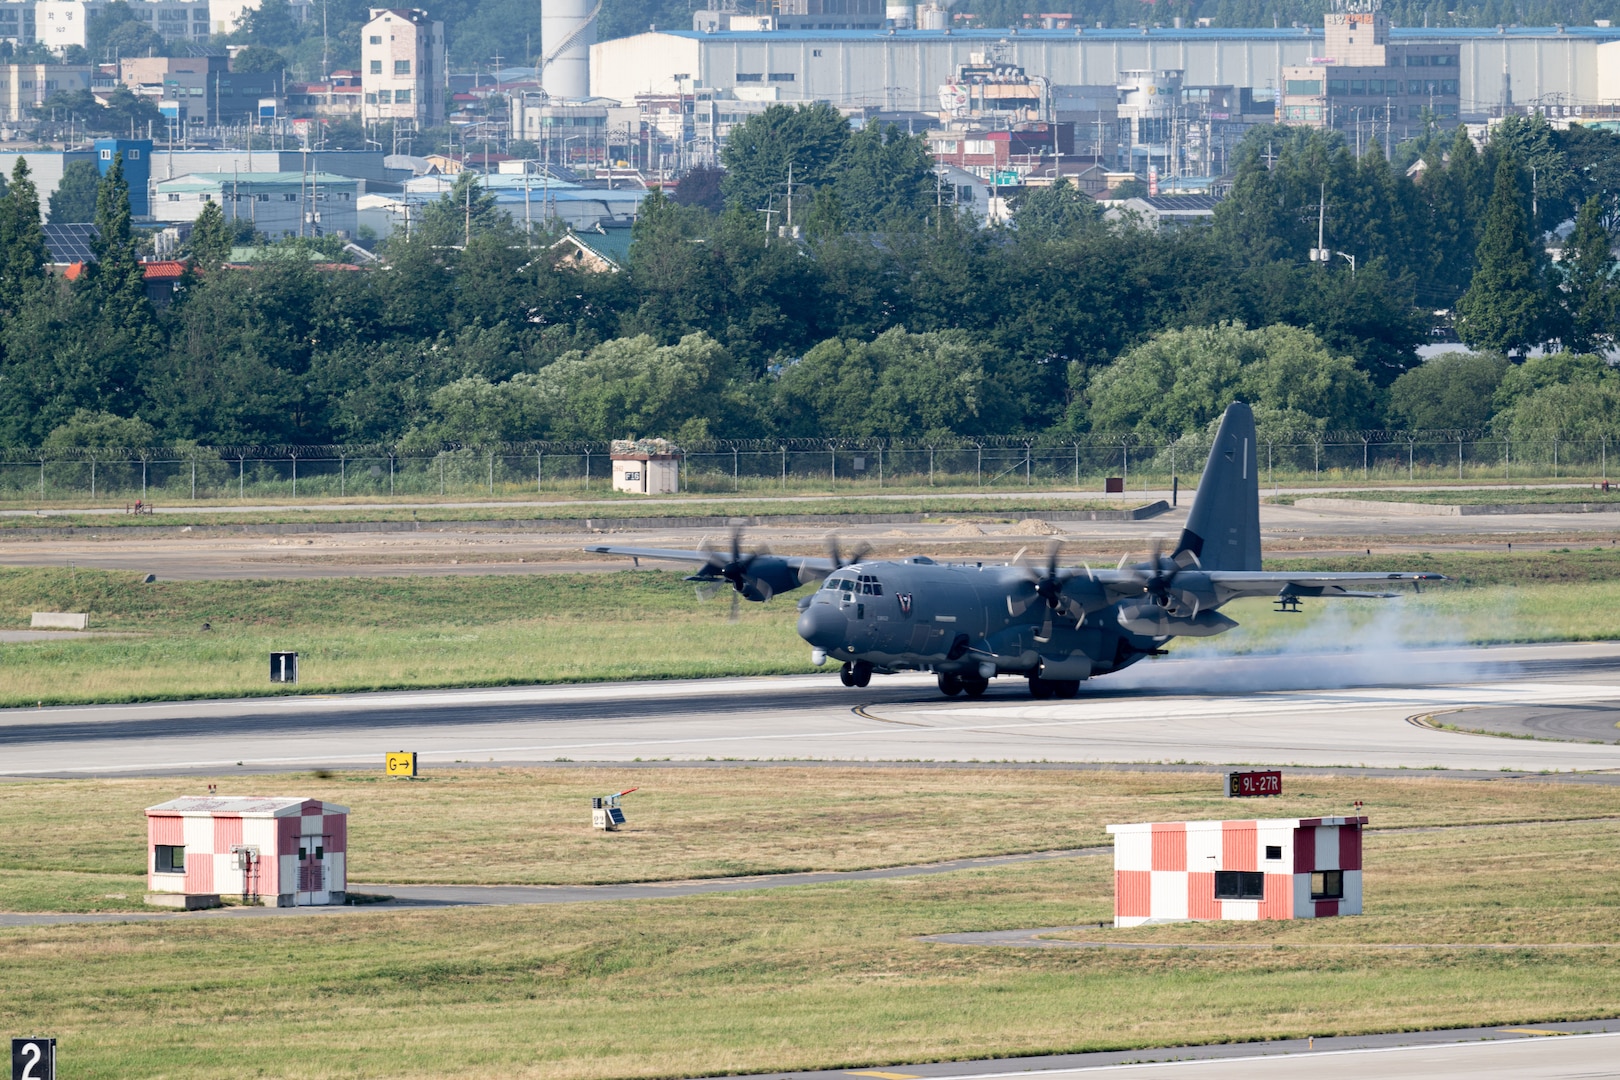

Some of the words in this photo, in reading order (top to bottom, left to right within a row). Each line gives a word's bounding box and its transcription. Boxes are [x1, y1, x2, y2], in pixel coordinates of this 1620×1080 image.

[280, 655, 286, 682] 1
[389, 757, 397, 771] G
[1232, 778, 1239, 792] G
[1243, 776, 1278, 791] 9L-27R
[21, 1042, 41, 1080] 2
